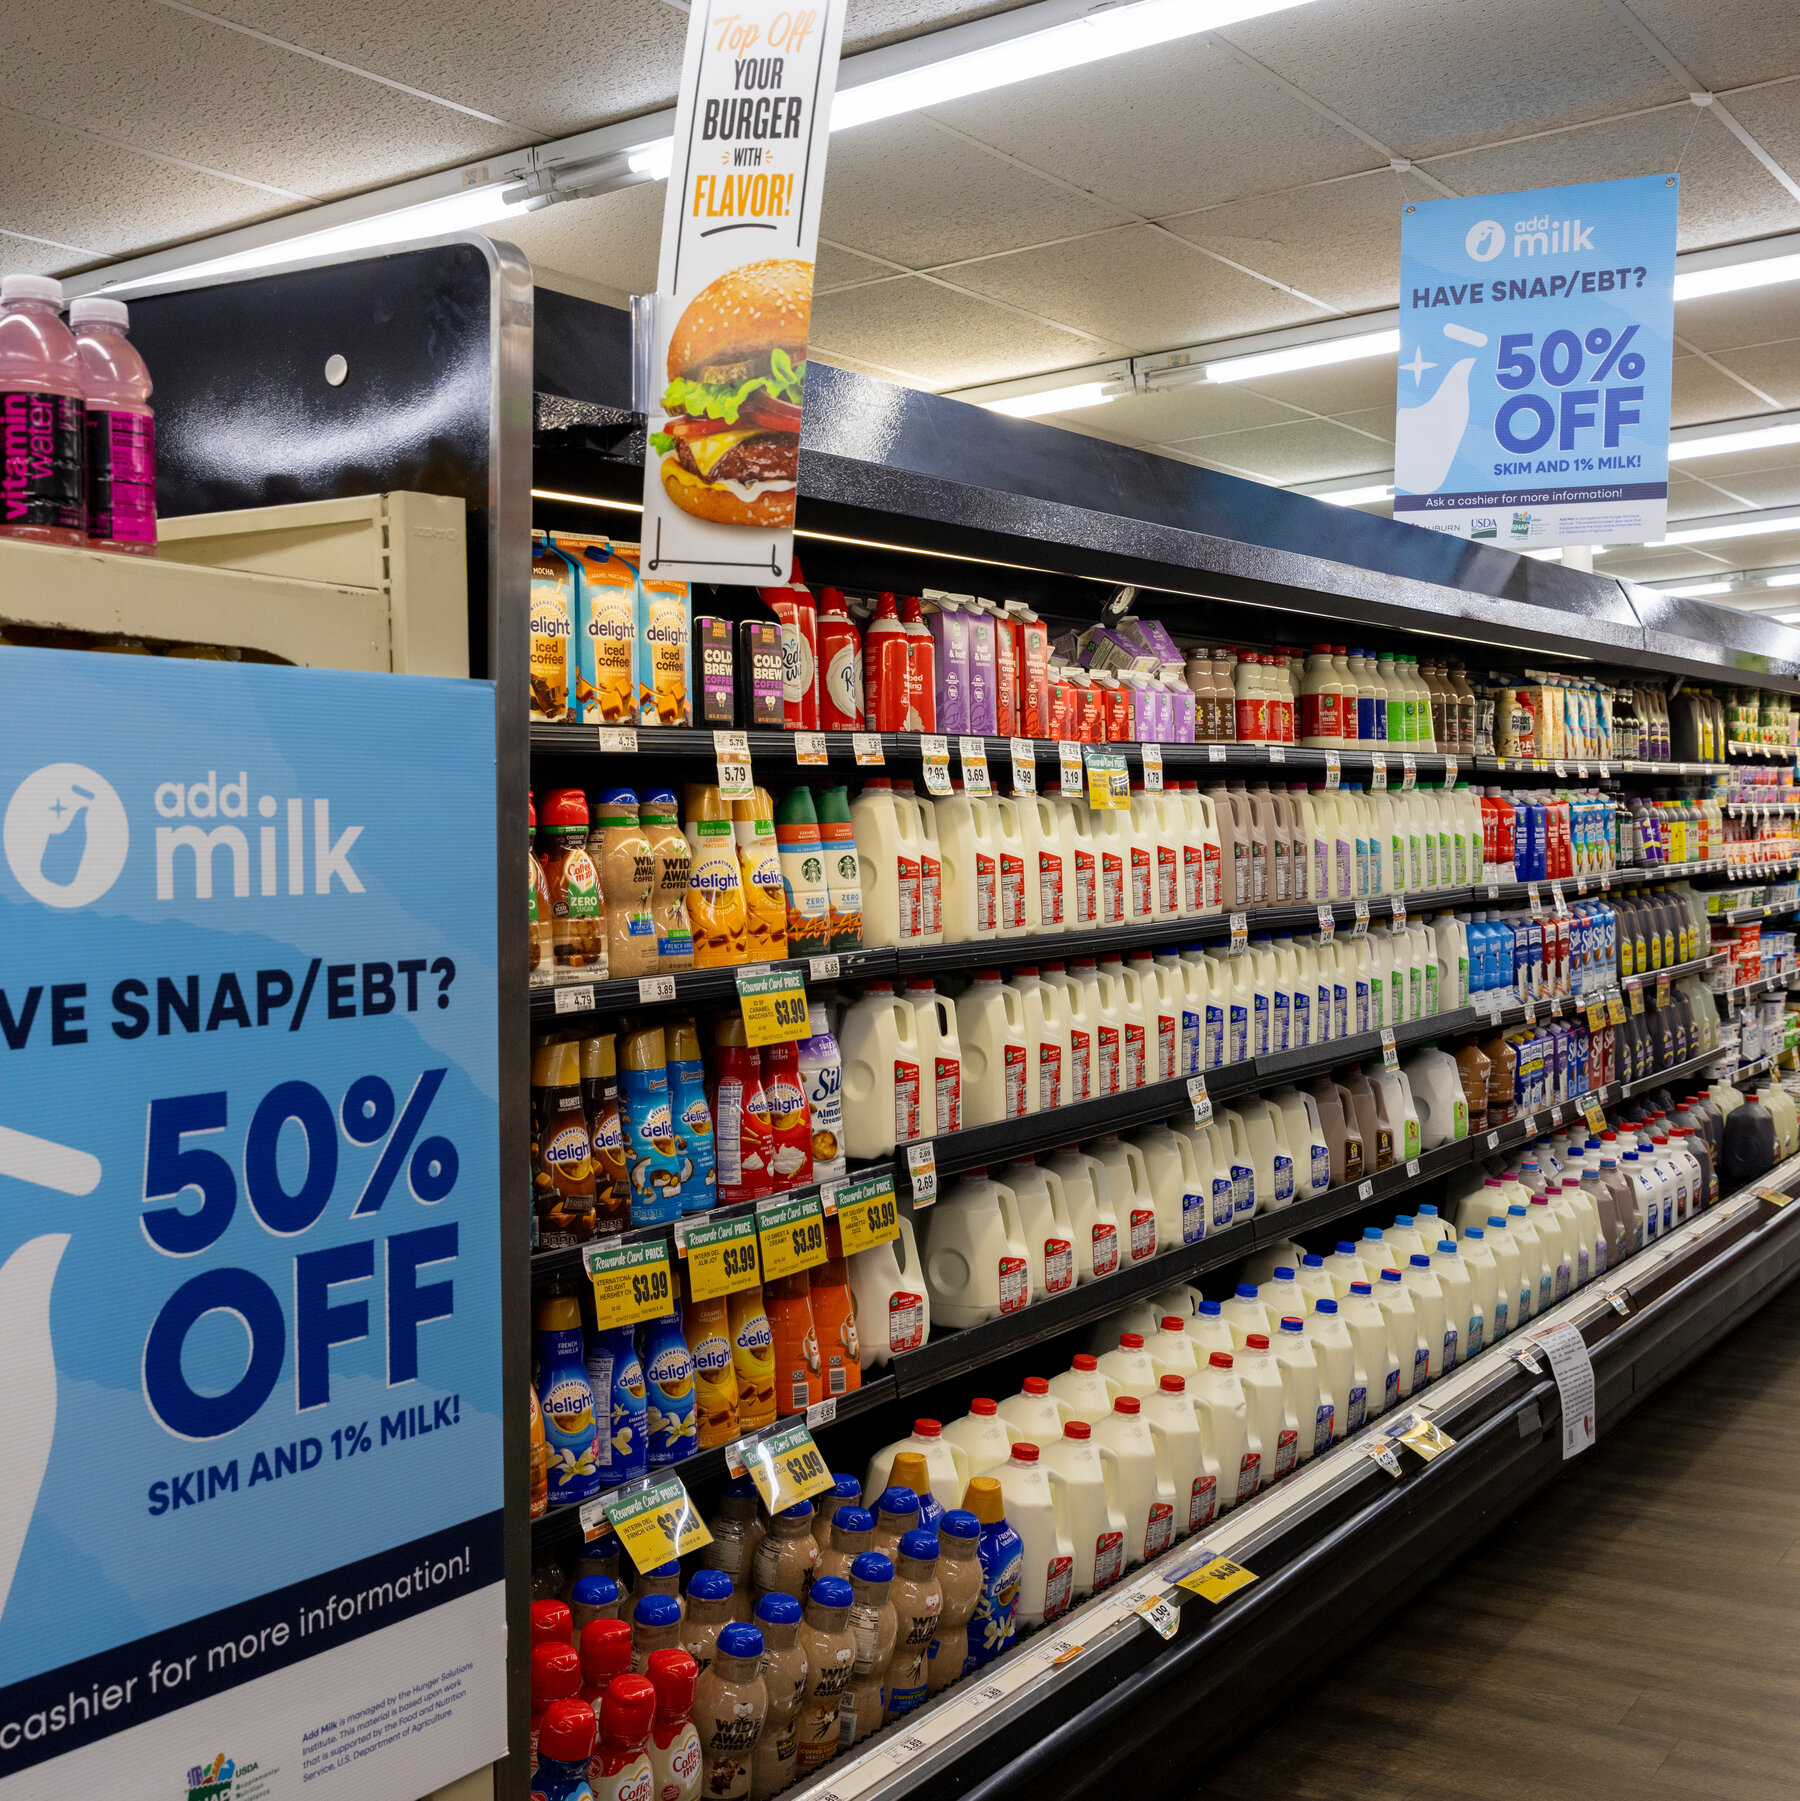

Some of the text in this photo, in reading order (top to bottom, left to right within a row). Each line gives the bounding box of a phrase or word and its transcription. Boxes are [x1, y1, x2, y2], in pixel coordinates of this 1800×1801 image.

[714, 8, 817, 59] Top Off
[734, 58, 784, 90] YOUR
[702, 97, 802, 140] BURGER
[734, 148, 762, 166] WITH
[693, 173, 794, 217] FLAVOR!
[1514, 215, 1549, 233] add
[1514, 220, 1595, 257] milk
[1413, 266, 1647, 309] HAVE SNAP/EBT?
[1495, 325, 1645, 392] 50%
[1494, 386, 1644, 455] OFF
[30, 395, 53, 479] water
[1, 394, 28, 519] vitamin
[1494, 455, 1641, 476] SKIM AND 1% MILK!
[1426, 498, 1444, 507] Ask
[1457, 495, 1497, 505] cashier
[1502, 494, 1517, 503] for
[1520, 493, 1549, 502] more
[1552, 489, 1622, 500] information!
[1471, 519, 1497, 528] USDA
[1512, 523, 1529, 531] SNAP
[533, 567, 554, 576] MOCHA
[589, 620, 634, 641] delight
[647, 626, 688, 646] delight
[536, 640, 558, 653] iced
[604, 643, 624, 655] iced
[661, 648, 679, 660] iced
[704, 649, 732, 662] COLD
[531, 654, 563, 664] coffee
[599, 656, 629, 667] coffee
[656, 661, 683, 671] coffee
[754, 655, 781, 668] COLD
[705, 664, 732, 675] BREW
[754, 668, 782, 680] BREW
[705, 676, 733, 684] COFFEE
[729, 739, 744, 747] 5.79
[724, 766, 746, 782] 5.79
[967, 768, 984, 781] 3.69
[1016, 769, 1031, 783] 5.99
[1064, 771, 1079, 783] 3.19
[1147, 772, 1159, 783] 1.79
[155, 771, 247, 818] add
[156, 795, 366, 900] milk
[568, 863, 592, 877] Coffee
[690, 873, 738, 890] delight
[570, 897, 597, 906] ZERO
[825, 963, 838, 972] 6.85
[658, 985, 672, 995] 3.89
[742, 976, 800, 993] Rewards Card PRICE
[111, 957, 456, 1039] SNAP/EBT?
[574, 995, 592, 1006] 4.79
[775, 998, 806, 1028] $3.99
[139, 1068, 459, 1258] 50%
[839, 1180, 891, 1204] Rewards Card PRICE
[917, 1175, 933, 1192] 2.69
[760, 1202, 818, 1228] Rewards Card PRICE
[867, 1201, 895, 1233] $3.99
[689, 1222, 751, 1246] Rewards Card PRICE
[792, 1223, 822, 1256] $3.99
[595, 1246, 664, 1270] Rewards Card PRICE
[694, 1252, 709, 1261] INTERN
[723, 1244, 755, 1279] $3.99
[604, 1283, 626, 1292] DELIGHT
[632, 1271, 667, 1306] $3.99
[142, 1222, 459, 1442] OFF
[543, 1393, 593, 1415] delight
[148, 1394, 461, 1516] SKIM AND 1% MILK!
[786, 1450, 824, 1485] $3.99
[611, 1484, 682, 1522] Rewards Card PRICE
[623, 1518, 653, 1535] INTERN DEL
[627, 1524, 656, 1541] FRNCH VAN
[1209, 1563, 1241, 1580] $4.59
[1150, 1605, 1170, 1623] 4.99
[0, 1547, 470, 1751] cashier for more information!
[1054, 1642, 1071, 1653] 7.95
[302, 1662, 473, 1742] Add Milk is managed by the Hunger Solutions
[983, 1688, 1002, 1700] 3.89
[303, 1680, 462, 1756] Institute. This material is based upon work
[303, 1690, 466, 1769] that is supported by the Food and Nutrition
[303, 1709, 453, 1783] Service, U.S. Department of Agriculture.
[903, 1738, 923, 1752] 3.89
[236, 1762, 258, 1778] USDA
